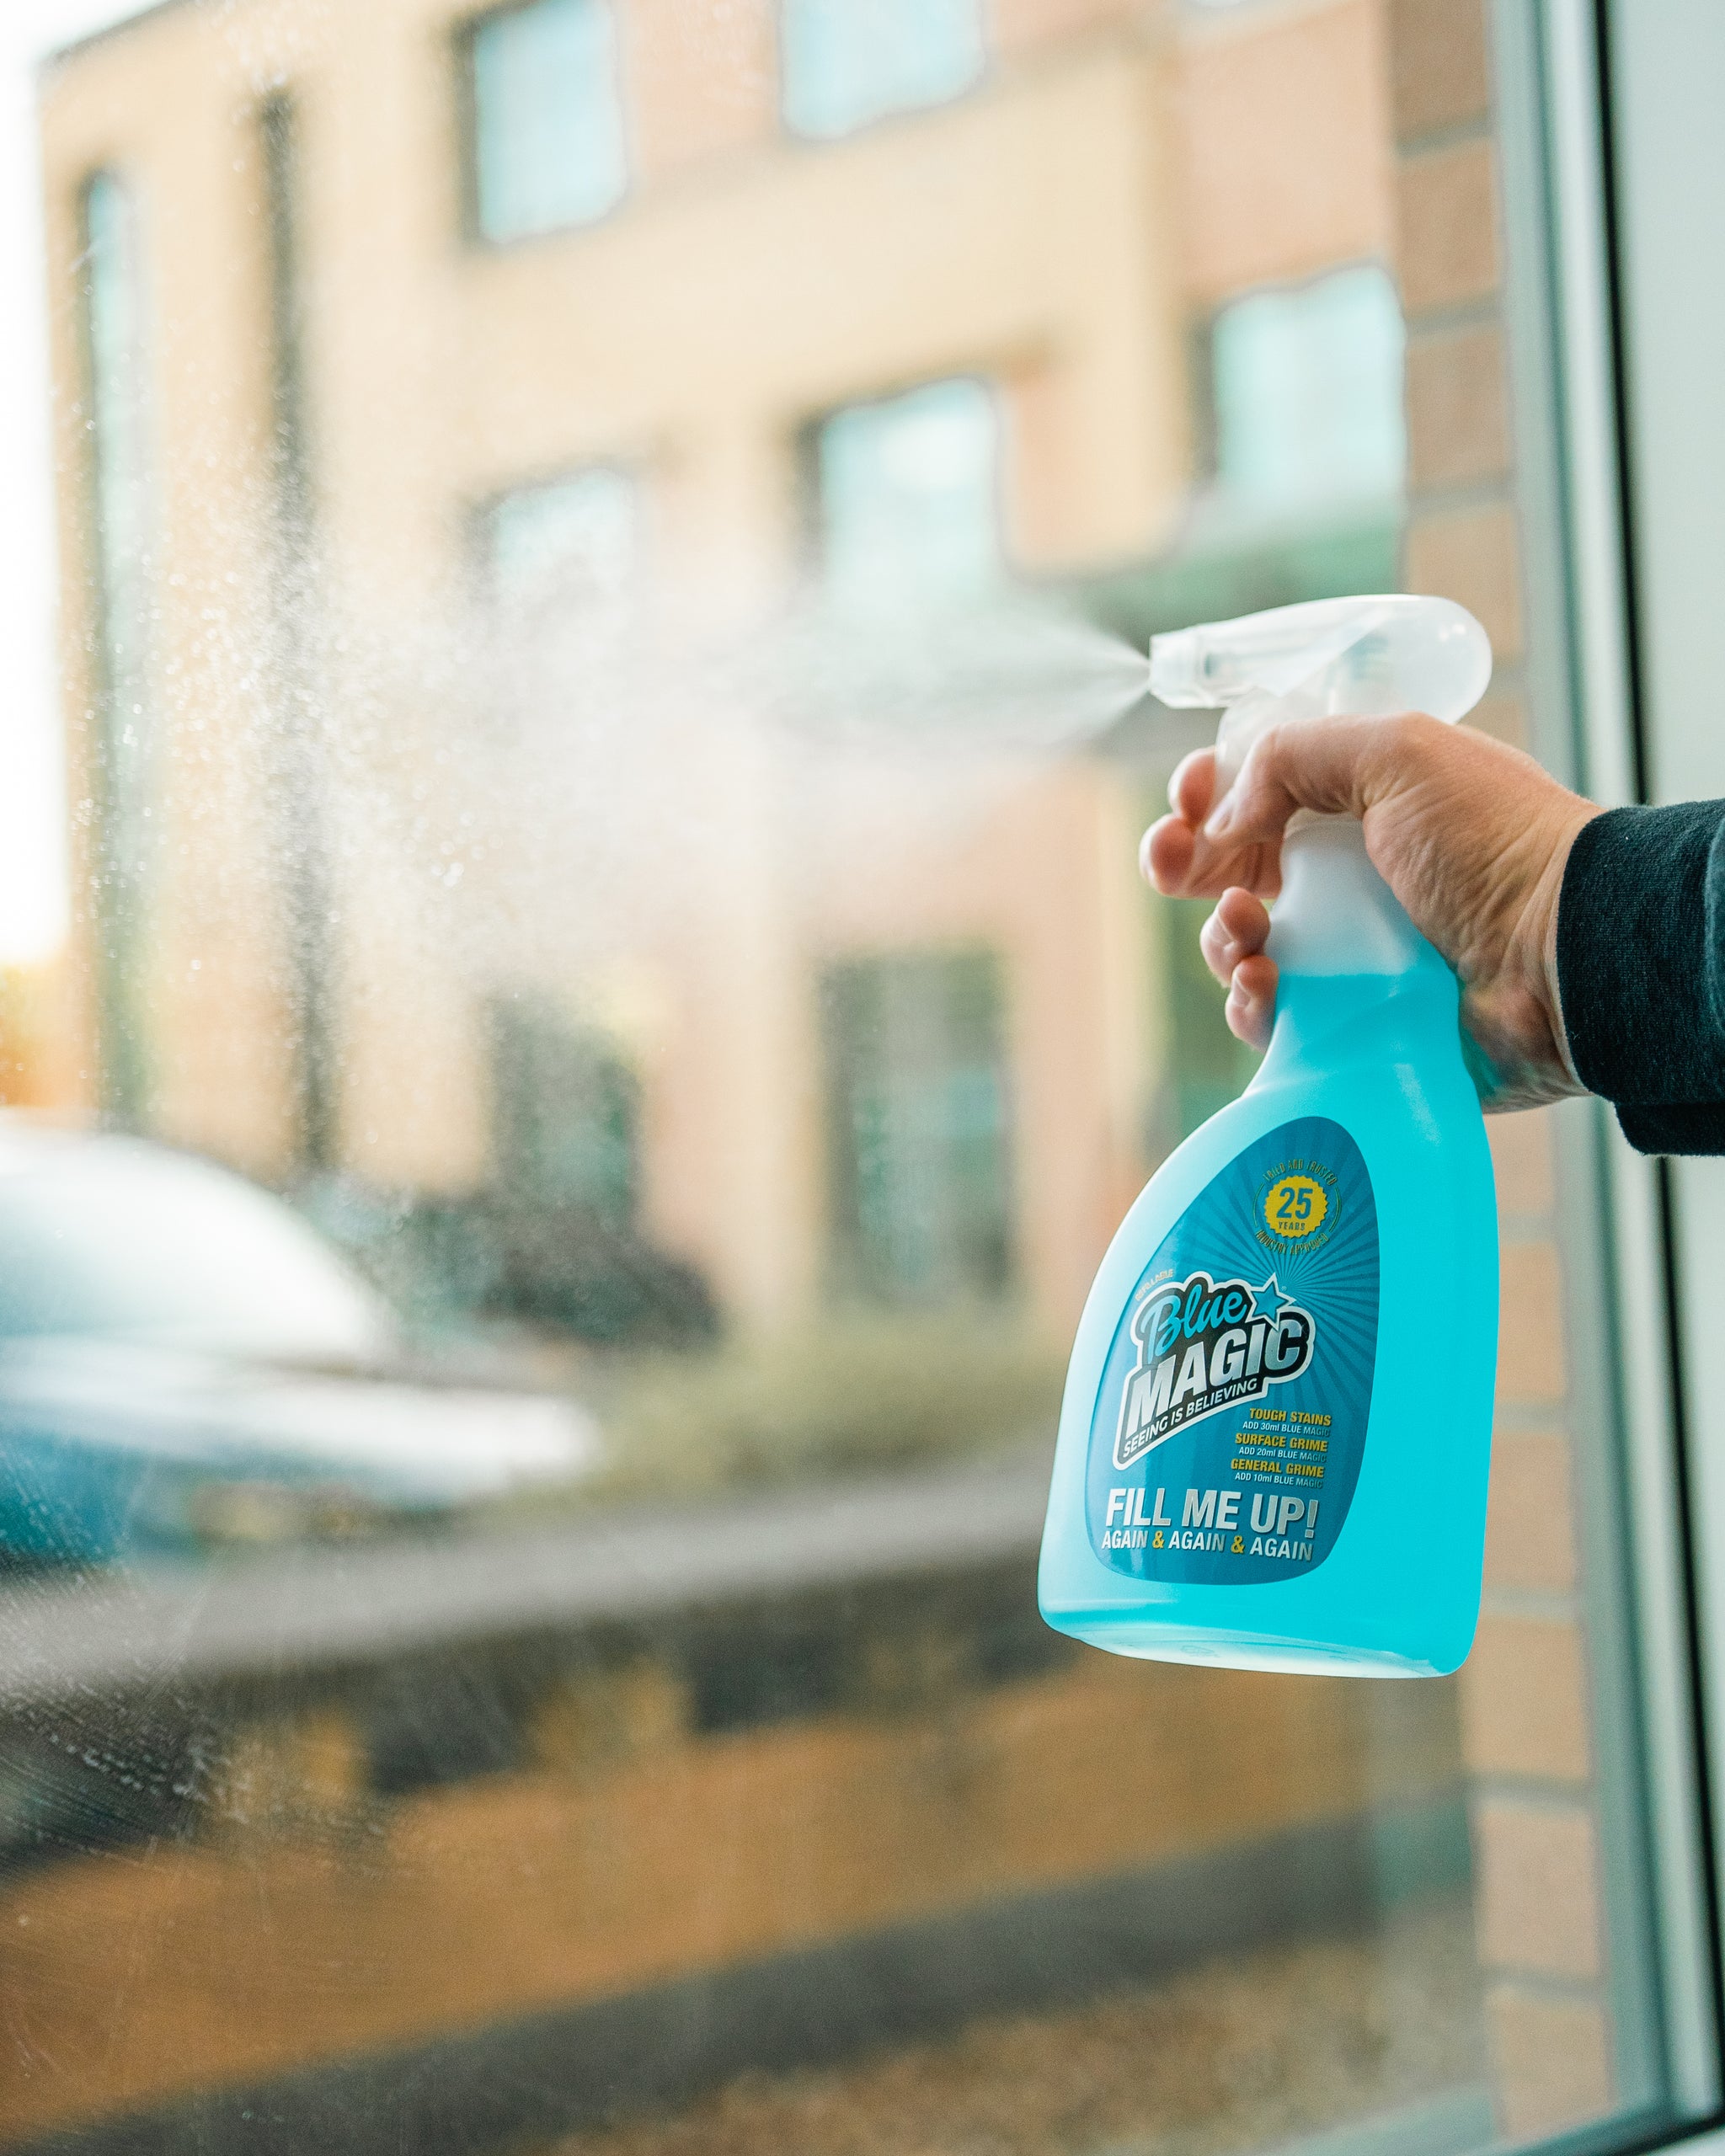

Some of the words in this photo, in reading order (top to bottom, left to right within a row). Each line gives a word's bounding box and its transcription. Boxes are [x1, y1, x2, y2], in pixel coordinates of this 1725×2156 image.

[1277, 1187, 1313, 1219] 25
[1279, 1222, 1306, 1230] YEARS
[1141, 1284, 1247, 1364] Blue
[1125, 1320, 1302, 1438] MAGIC
[1123, 1417, 1167, 1458] SEEING
[1171, 1407, 1183, 1425] IS
[1186, 1379, 1258, 1417] BELIEVING
[1250, 1408, 1287, 1422] TOUGH
[1290, 1412, 1332, 1426] STAINS
[1261, 1422, 1279, 1431] 30ml
[1282, 1425, 1301, 1433] BLUE
[1304, 1427, 1330, 1437] MAGIC
[1235, 1433, 1286, 1447] SURFACE
[1290, 1438, 1327, 1451] GRIME
[1239, 1447, 1255, 1455] ADD
[1257, 1449, 1275, 1457] 20ml
[1278, 1450, 1297, 1459] BLUE
[1300, 1453, 1327, 1462] MAGIC
[1231, 1459, 1282, 1473] GENERAL
[1286, 1464, 1324, 1477] GRIME
[1235, 1472, 1251, 1481] ADD
[1253, 1474, 1272, 1482] 10ml
[1274, 1476, 1294, 1485] BLUE
[1296, 1478, 1322, 1488] MAGIC
[1105, 1488, 1171, 1527] FILL
[1182, 1489, 1242, 1529] ME
[1251, 1494, 1318, 1539] UP!
[1102, 1530, 1148, 1549] AGAIN
[1152, 1531, 1164, 1548] &
[1168, 1531, 1225, 1551] AGAIN
[1231, 1535, 1245, 1553] &
[1250, 1538, 1313, 1561] AGAIN
